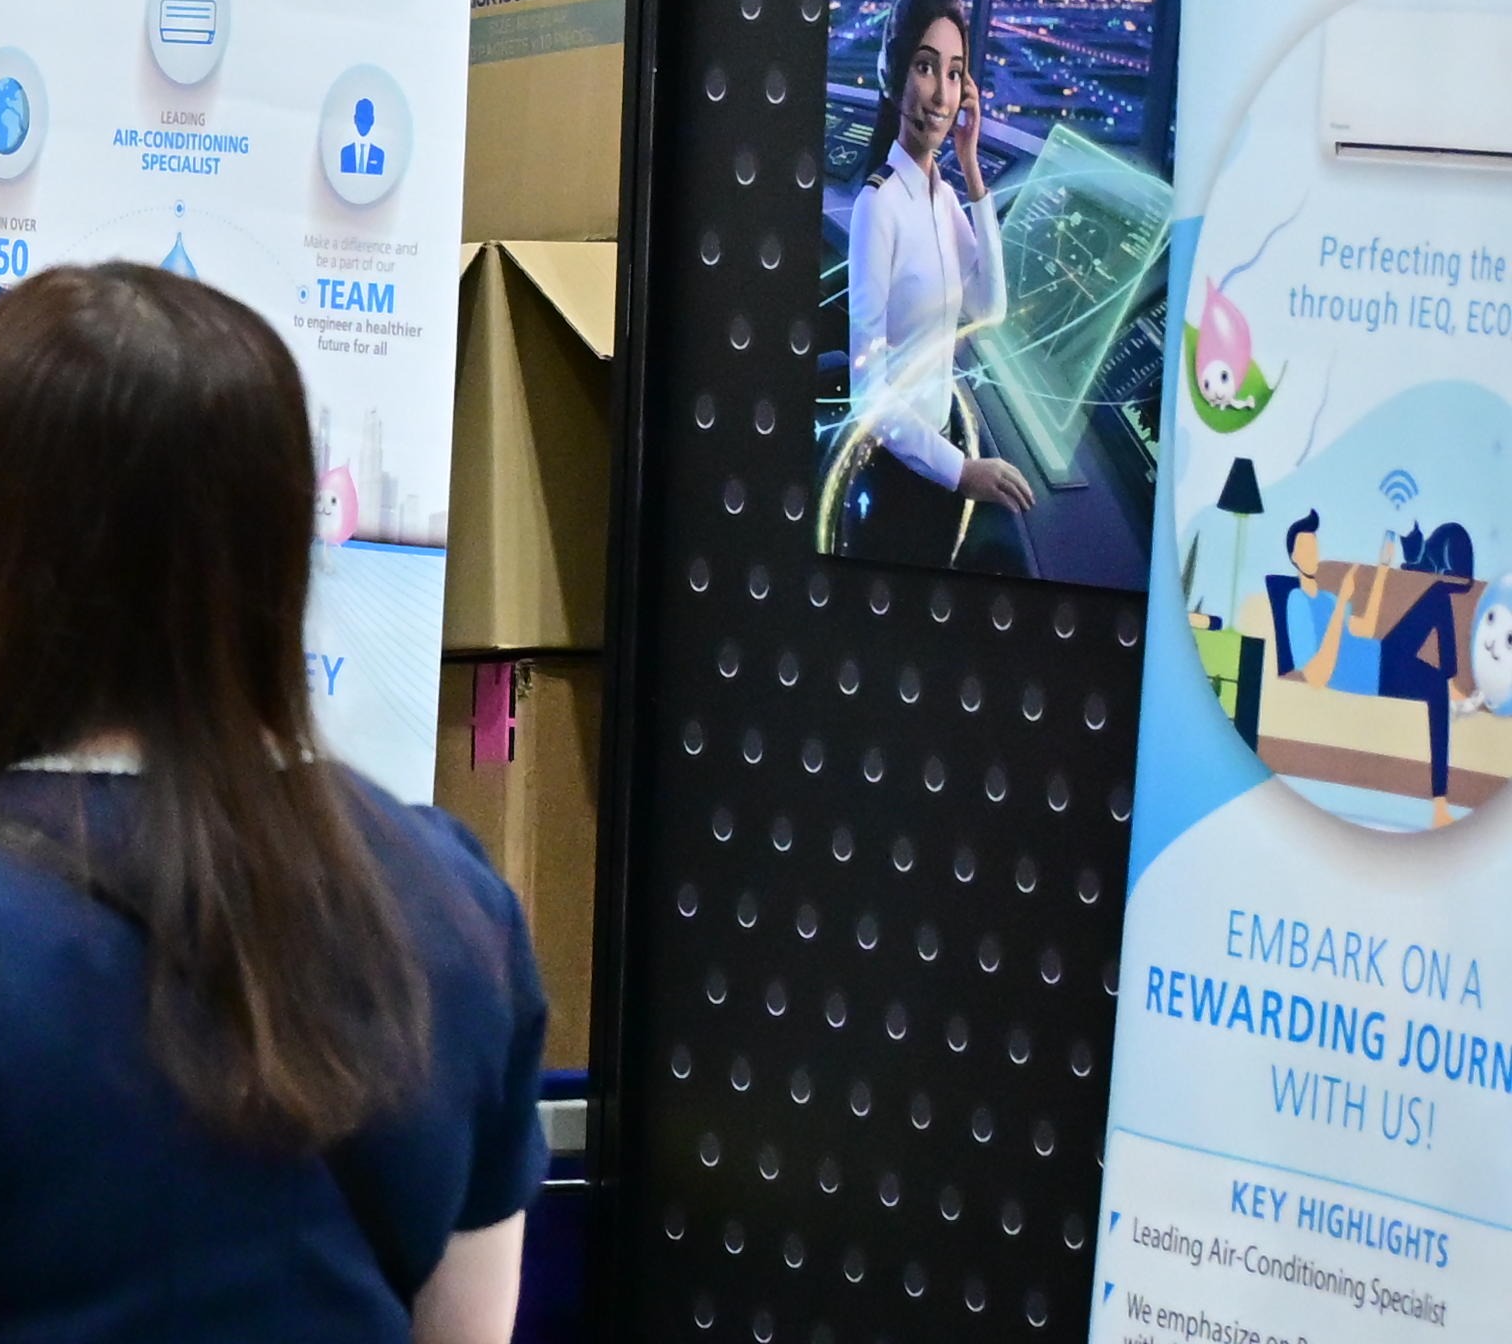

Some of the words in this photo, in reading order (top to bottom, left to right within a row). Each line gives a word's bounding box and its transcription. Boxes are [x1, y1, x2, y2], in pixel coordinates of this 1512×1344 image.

[160, 110, 207, 126] LEADING
[112, 128, 248, 153] AIR-CONDITIONING
[141, 152, 220, 174] SPECIALIST
[9, 217, 36, 231] OVER
[1320, 236, 1462, 287] Perfecting
[1470, 243, 1507, 283] the
[317, 278, 394, 313] TEAM
[1289, 284, 1397, 332] through
[1467, 300, 1512, 336] ECO
[293, 314, 304, 327] to
[306, 317, 352, 332] engineer
[355, 321, 362, 332] a
[365, 319, 422, 337] healthier
[317, 335, 350, 352] future
[353, 338, 369, 353] for
[373, 340, 387, 355] all
[1227, 909, 1387, 986] EMBARK
[1402, 944, 1450, 1000] ON
[1460, 959, 1481, 1008] A
[1146, 965, 1384, 1061] REWARDING
[1398, 1020, 1512, 1097] JOURN
[1271, 1064, 1366, 1131] WITH
[1382, 1090, 1434, 1149] US!
[1231, 1180, 1287, 1222] KEY
[1297, 1195, 1448, 1268] HIGHLIGHTS
[1132, 1217, 1203, 1266] Leading
[1207, 1237, 1365, 1308] Air-Conditioning
[1369, 1277, 1446, 1326] Specialist
